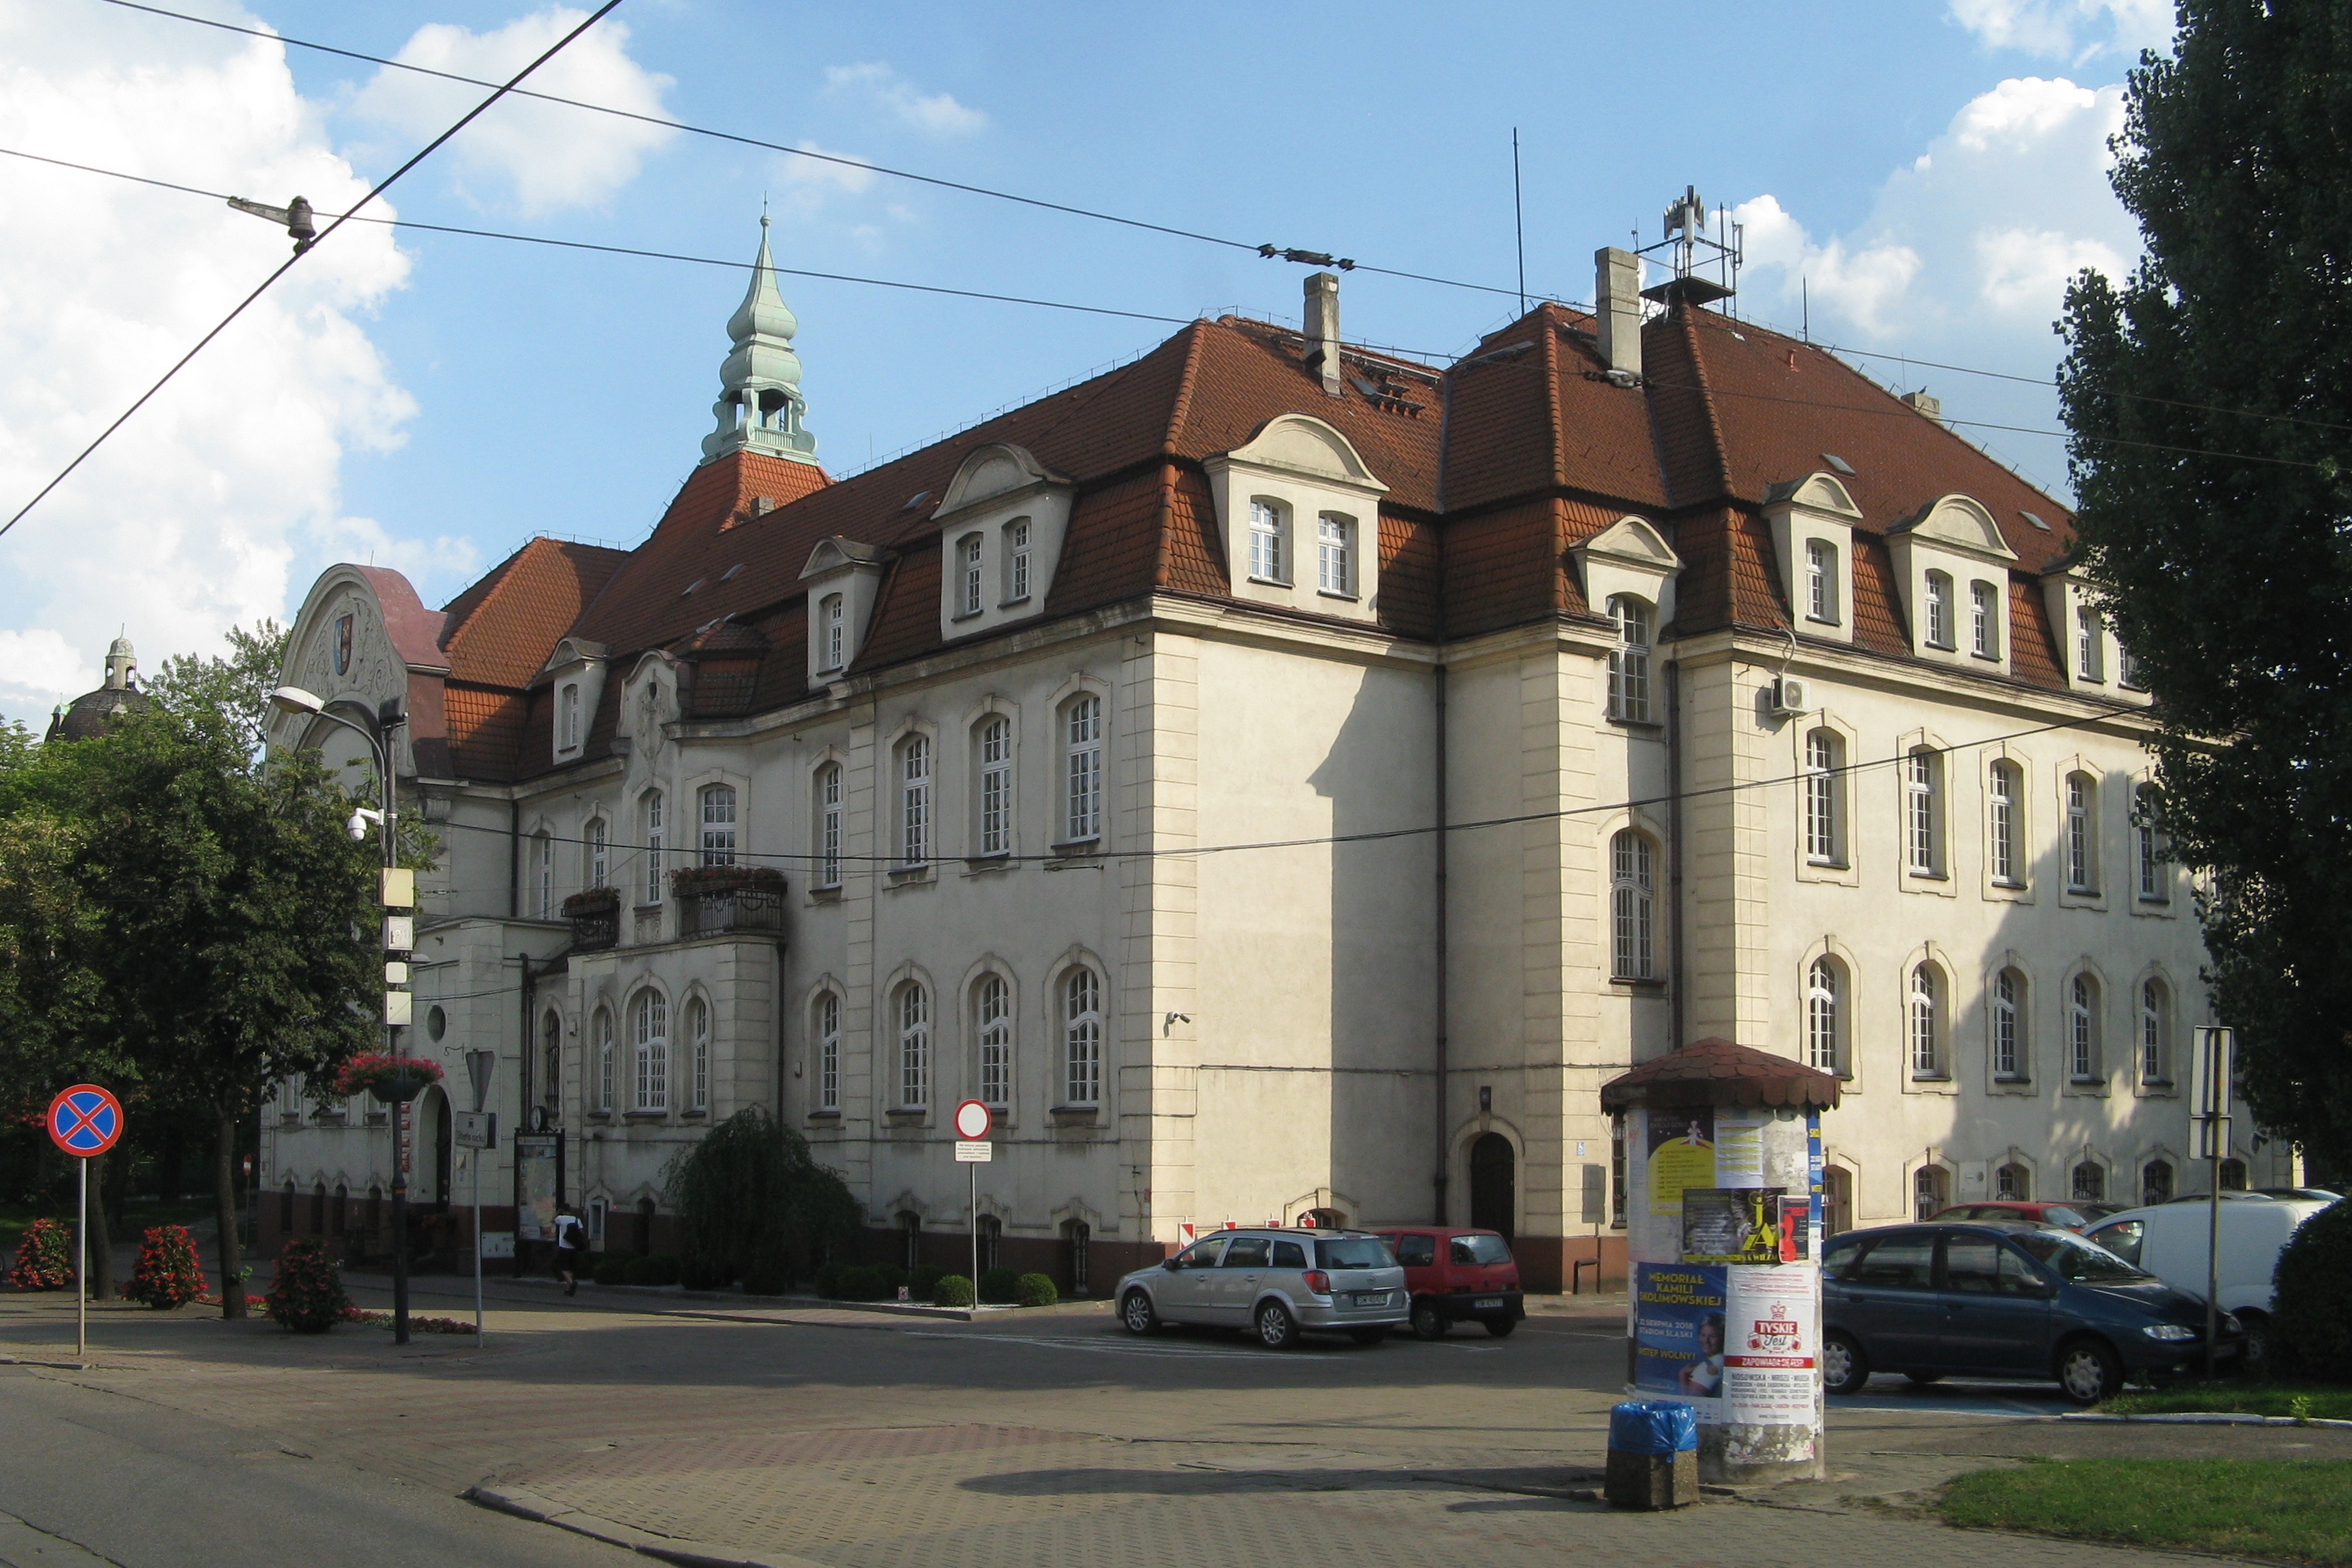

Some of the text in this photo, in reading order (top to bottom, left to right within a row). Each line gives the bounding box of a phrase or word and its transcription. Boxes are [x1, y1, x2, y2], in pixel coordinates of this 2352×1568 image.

[1649, 1272, 1704, 1285] MEMORIAŁ
[1656, 1283, 1694, 1294] KAMILI
[1639, 1291, 1723, 1306] SKOLIMOWSKIEJ
[1758, 1322, 1795, 1334] TYSKIE
[1764, 1334, 1787, 1346] Fest
[1659, 1349, 1696, 1360] WOLNY!
